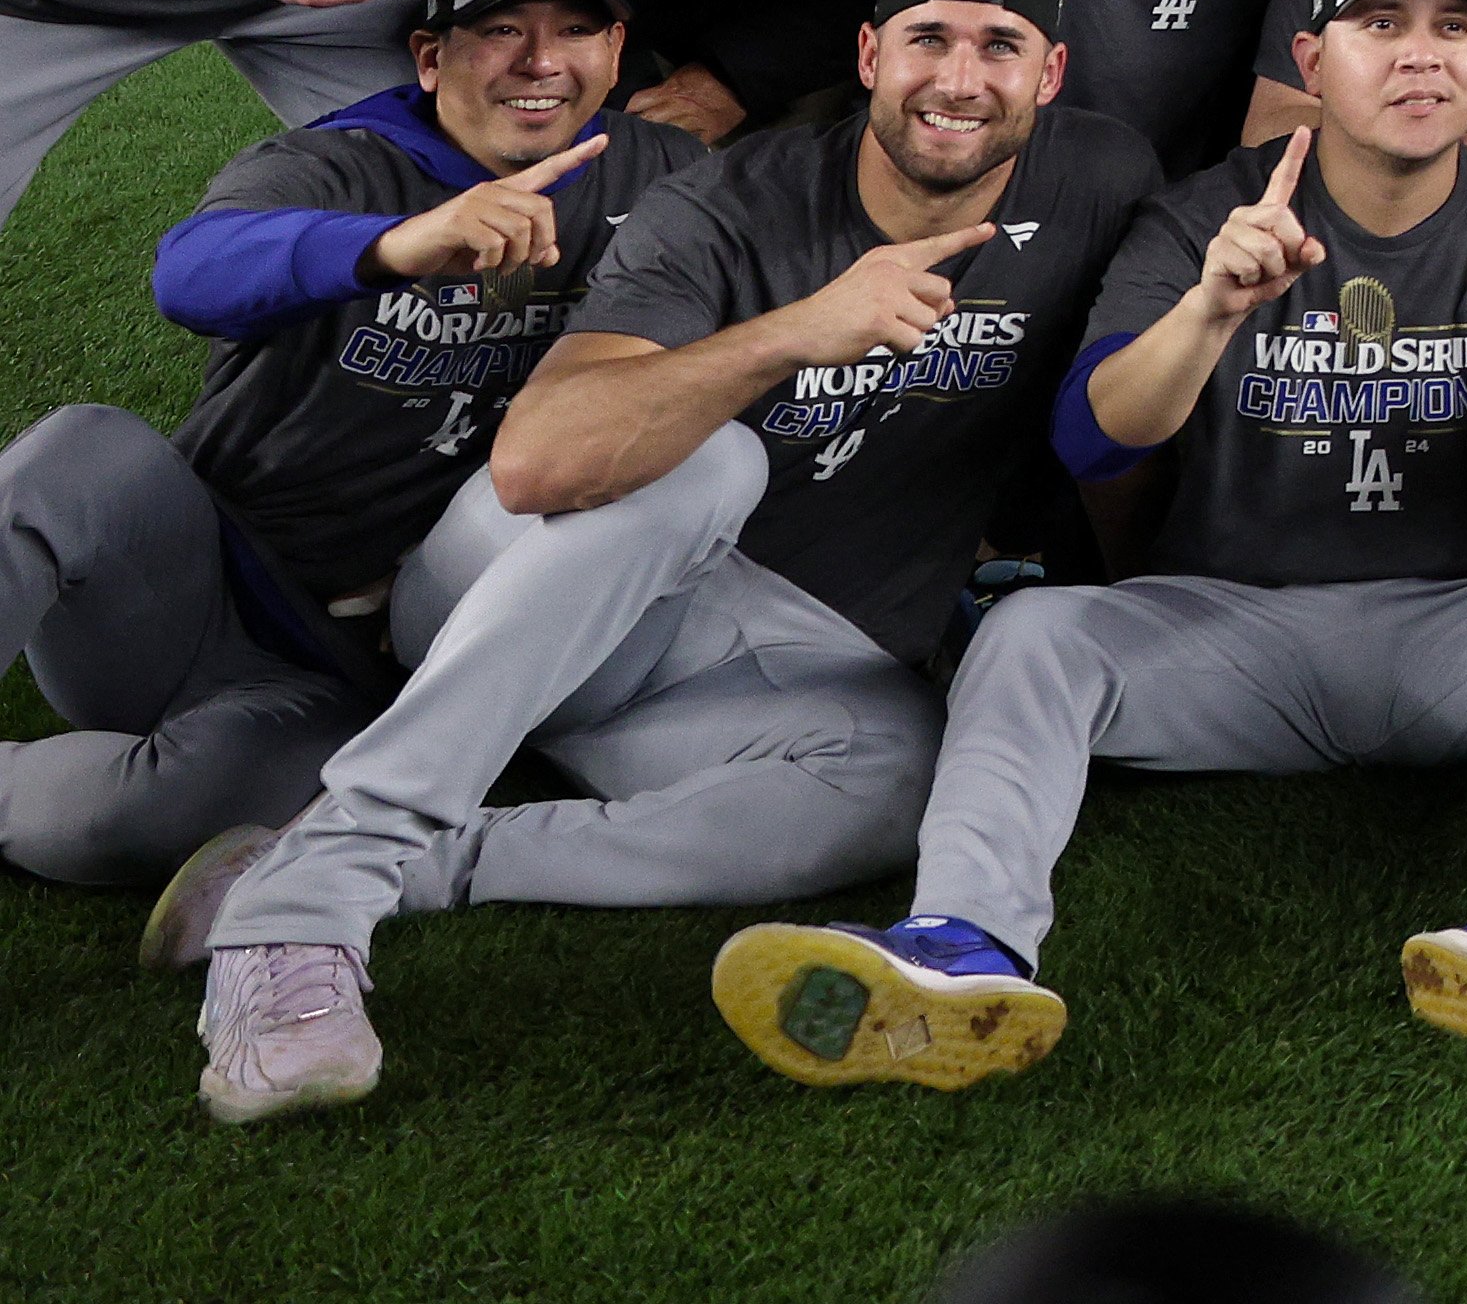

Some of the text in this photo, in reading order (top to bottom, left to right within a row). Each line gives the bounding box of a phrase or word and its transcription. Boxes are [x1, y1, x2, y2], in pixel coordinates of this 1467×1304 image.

[1254, 332, 1390, 374] WORLD
[1302, 439, 1431, 456] 20 24
